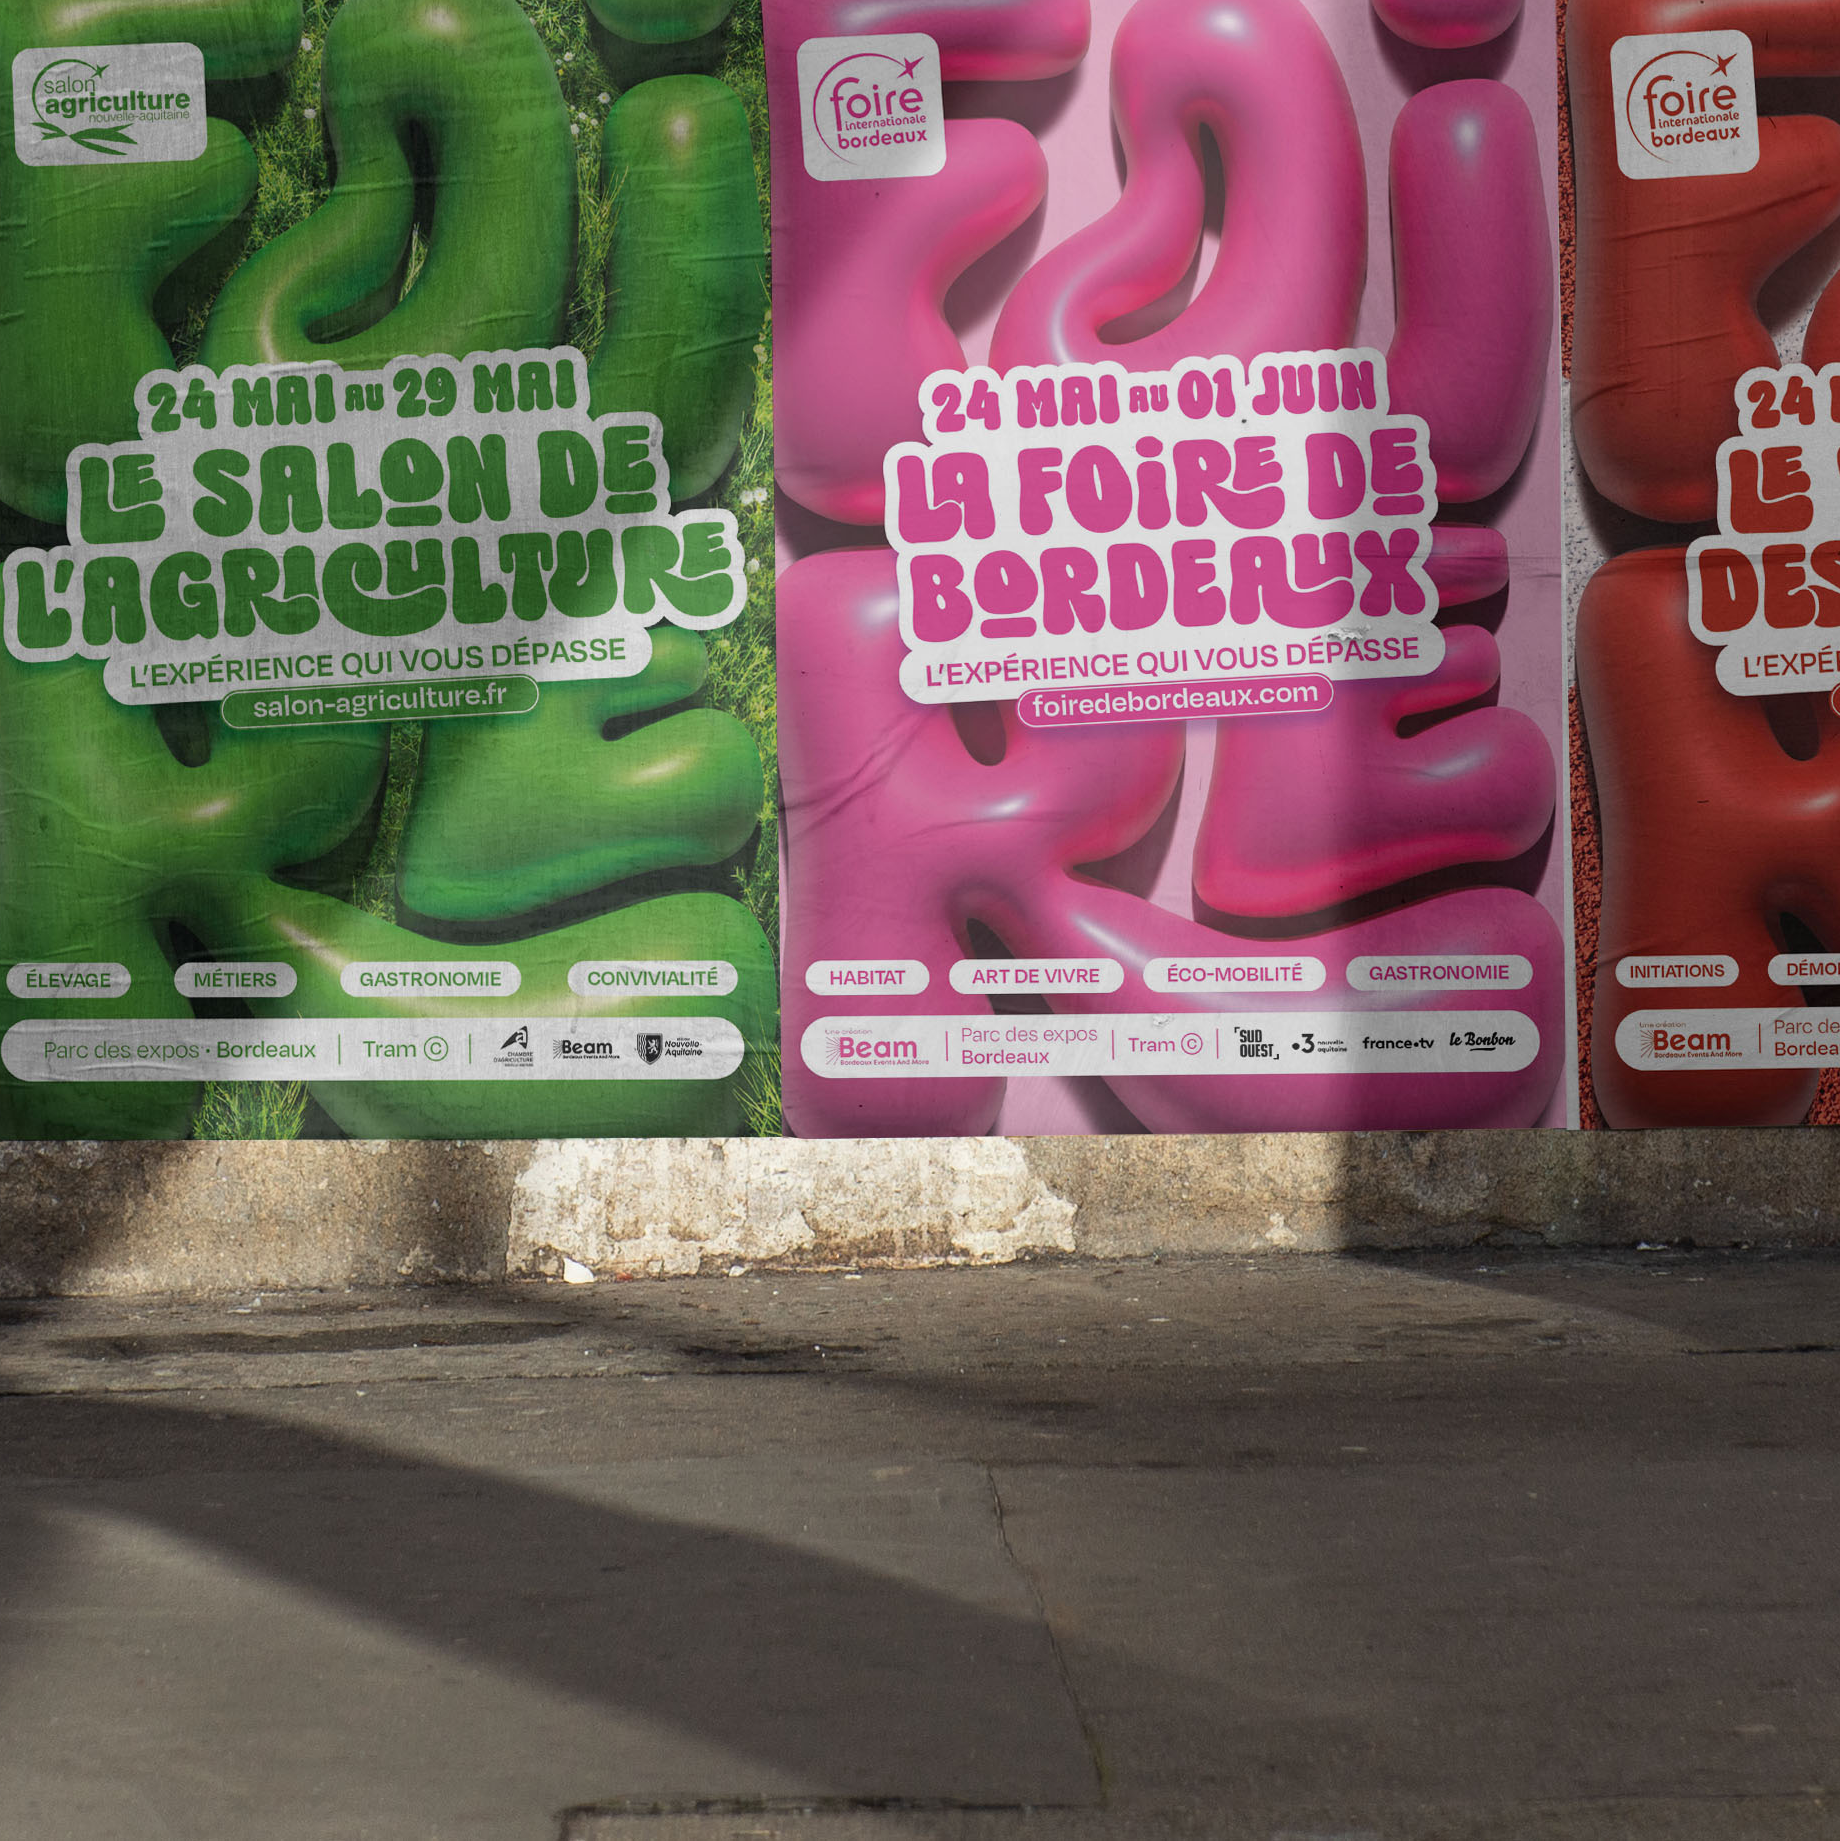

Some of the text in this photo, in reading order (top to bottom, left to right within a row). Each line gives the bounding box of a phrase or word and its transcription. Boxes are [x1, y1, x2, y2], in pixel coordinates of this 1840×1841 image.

[932, 360, 1377, 432] 24 MAI AU 01 JUIN
[79, 425, 657, 544] LE SALON DE
[897, 452, 995, 543] LA
[1306, 428, 1424, 519] DE
[1729, 446, 1813, 534] LE
[910, 528, 1426, 642] BORDEAUX
[342, 651, 392, 678] QUI
[399, 646, 483, 671] VOUS
[492, 636, 625, 667] DÉPASSE
[254, 682, 507, 717] salon-agriculture.fr
[1033, 686, 1317, 717] foiredebordeaux.com
[831, 970, 905, 985] HABITAT
[973, 969, 1099, 983] ART DE VIVRE
[1168, 963, 1302, 982] ÉCO-MOBILITÉ
[1370, 965, 1509, 980] GASTRONOMIE
[1631, 964, 1724, 978] INITIATIONS
[1775, 1020, 1812, 1034] Parc
[44, 1040, 315, 1061] Parc des expos Bordeaux
[363, 1041, 416, 1057] Tram
